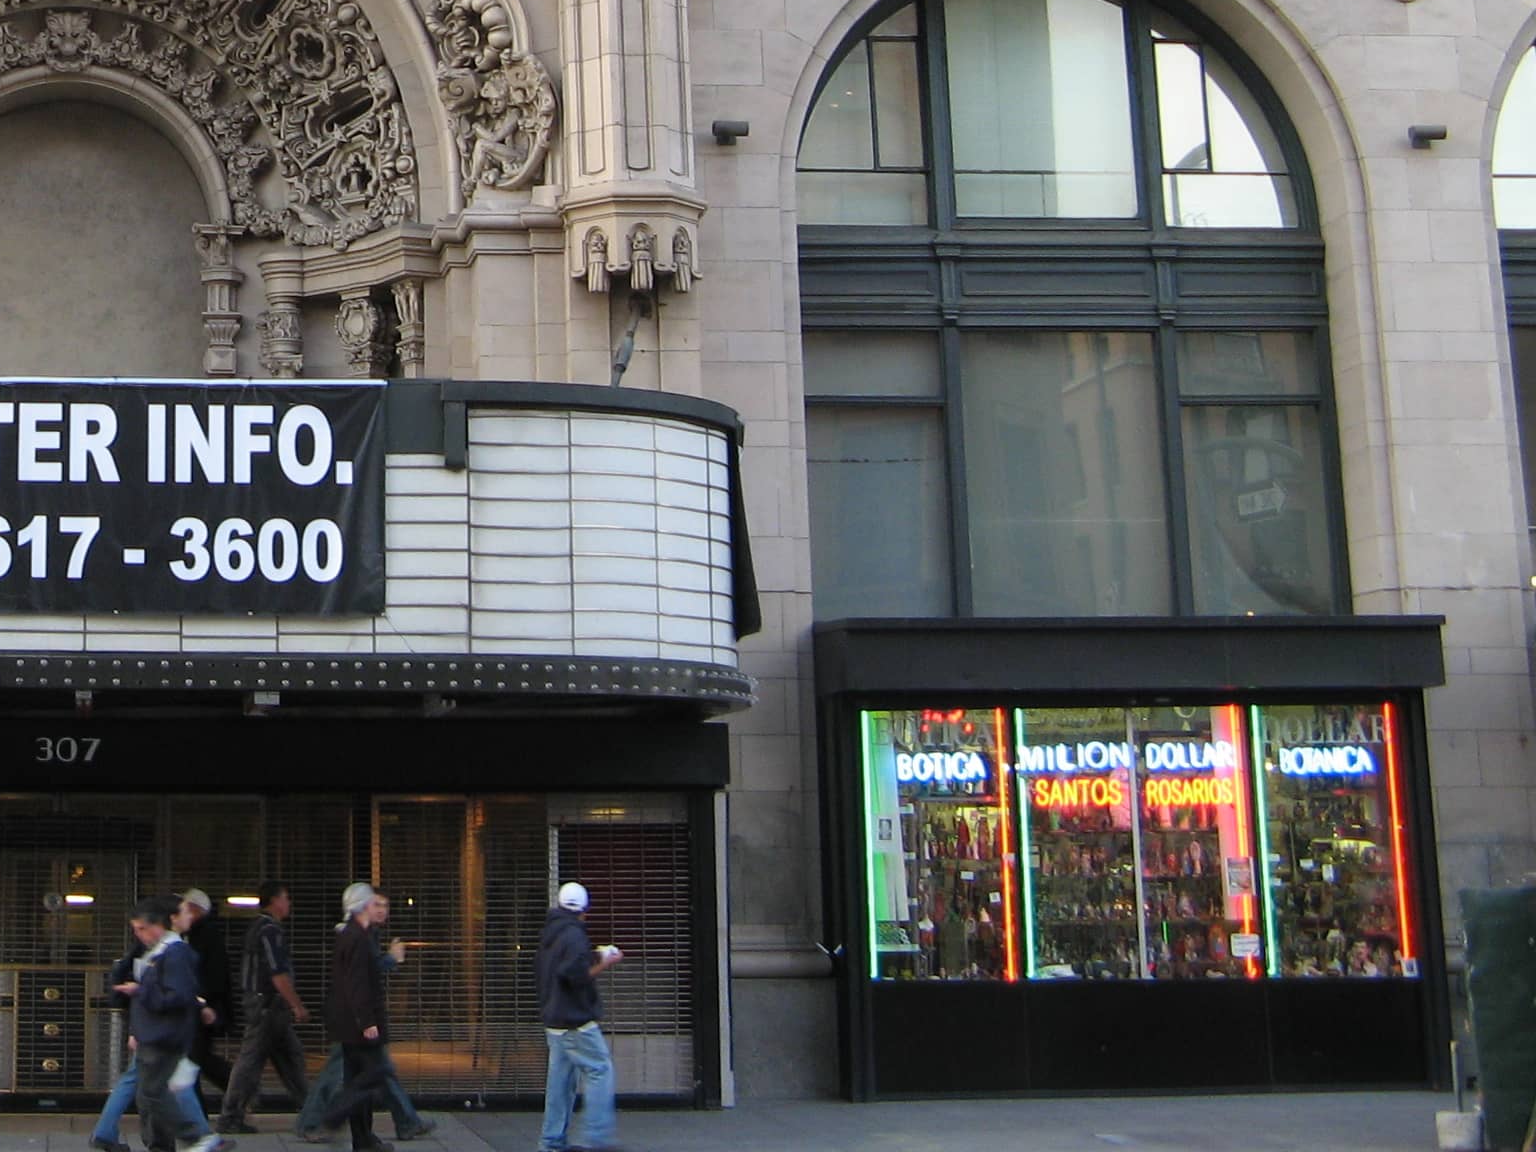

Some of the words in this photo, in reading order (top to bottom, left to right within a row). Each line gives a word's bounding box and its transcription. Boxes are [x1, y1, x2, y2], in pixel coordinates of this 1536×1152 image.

[147, 403, 354, 486] INFO.
[168, 516, 344, 583] 3600
[35, 737, 101, 762] 307
[1145, 741, 1235, 770] DOLLAR
[1278, 745, 1374, 776] BOTANICA
[896, 751, 987, 782] BOTICA
[1034, 777, 1123, 807] SANTOS
[1145, 778, 1234, 807] ROSARIOS
